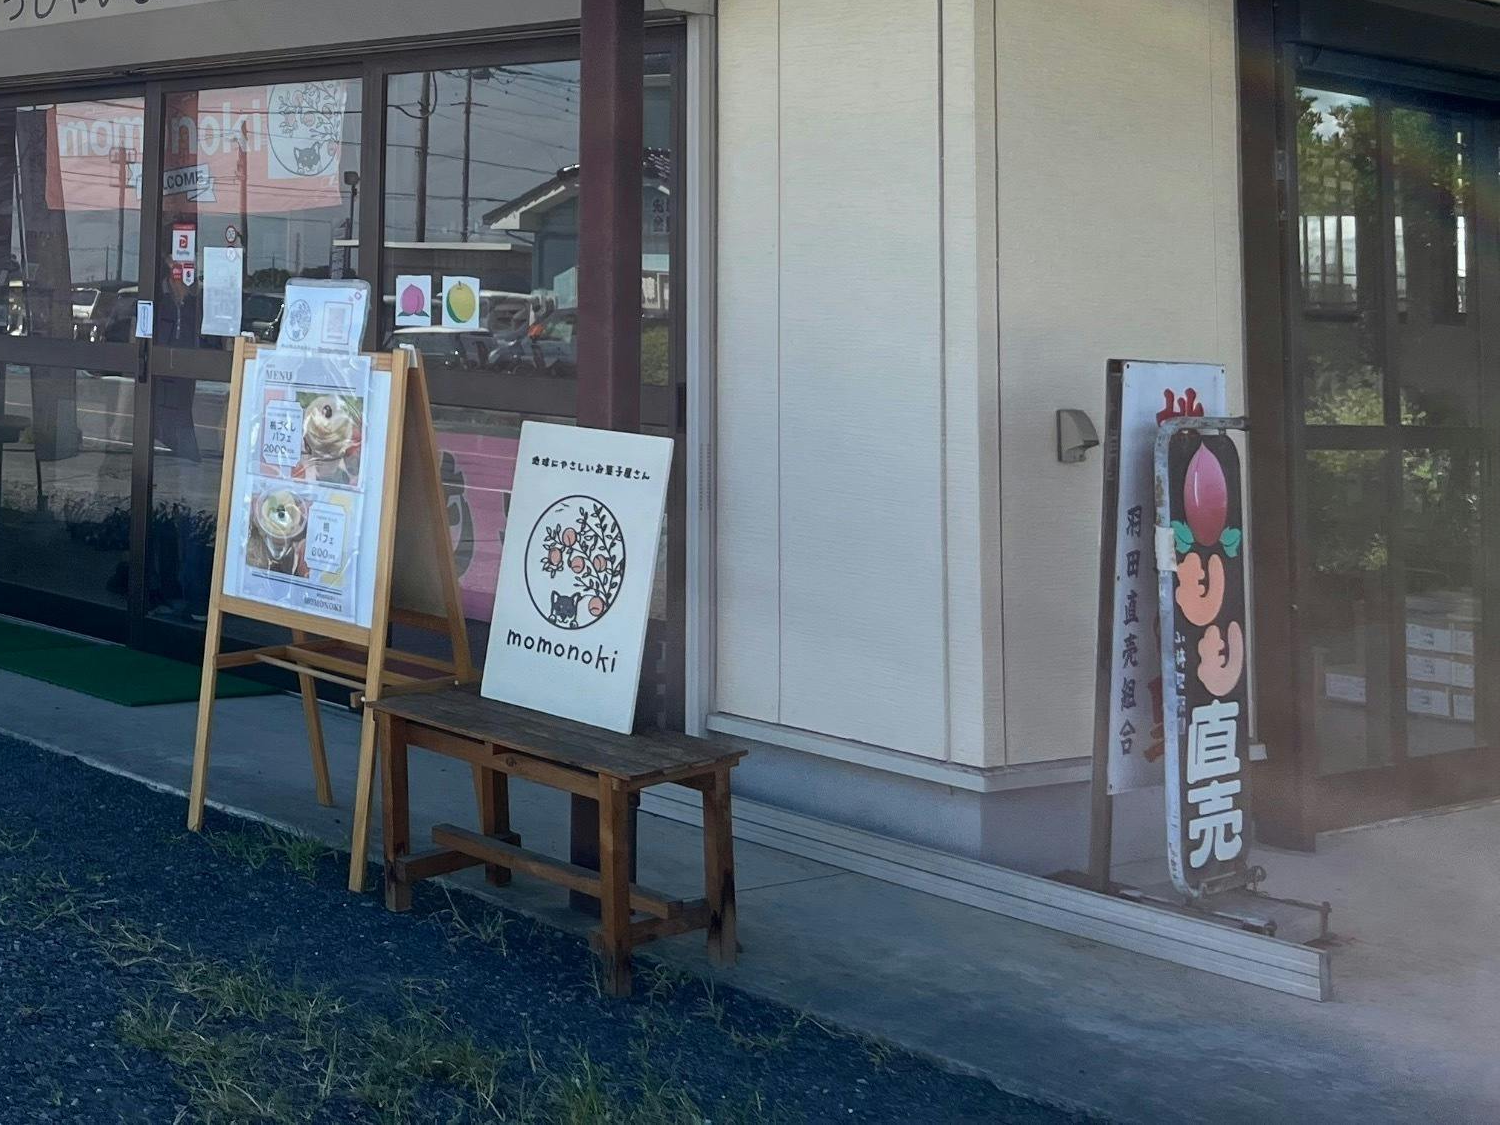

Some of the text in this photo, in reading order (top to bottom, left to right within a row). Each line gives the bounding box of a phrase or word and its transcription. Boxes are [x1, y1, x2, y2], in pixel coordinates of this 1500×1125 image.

[60, 99, 261, 157] momnoki
[265, 370, 293, 381] MENU
[506, 629, 619, 673] momonoki
